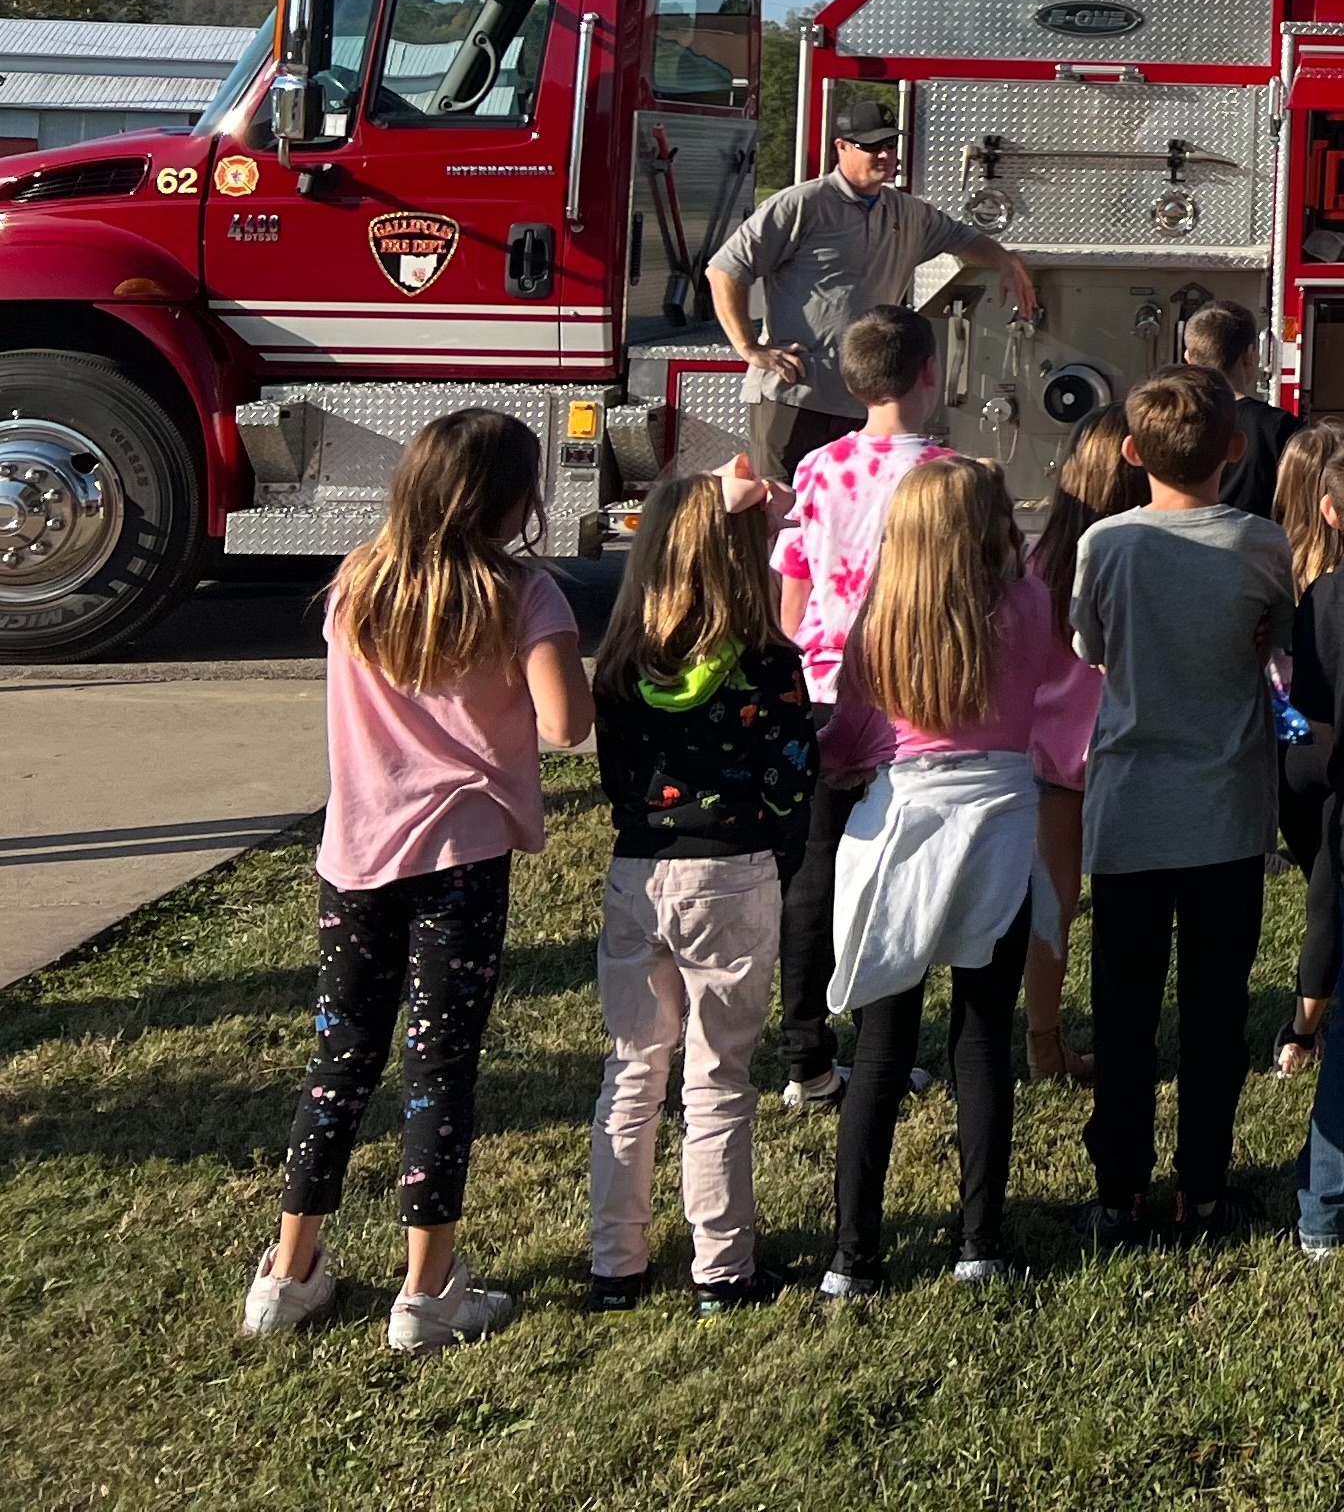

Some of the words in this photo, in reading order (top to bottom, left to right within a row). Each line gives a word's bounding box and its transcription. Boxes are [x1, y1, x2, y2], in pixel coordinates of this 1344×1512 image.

[1048, 9, 1128, 27] E-ONE
[446, 165, 556, 176] INTERNATIONAL
[156, 167, 199, 195] 62
[373, 218, 455, 240] GALLIPOLIS
[380, 238, 410, 254] FIRE
